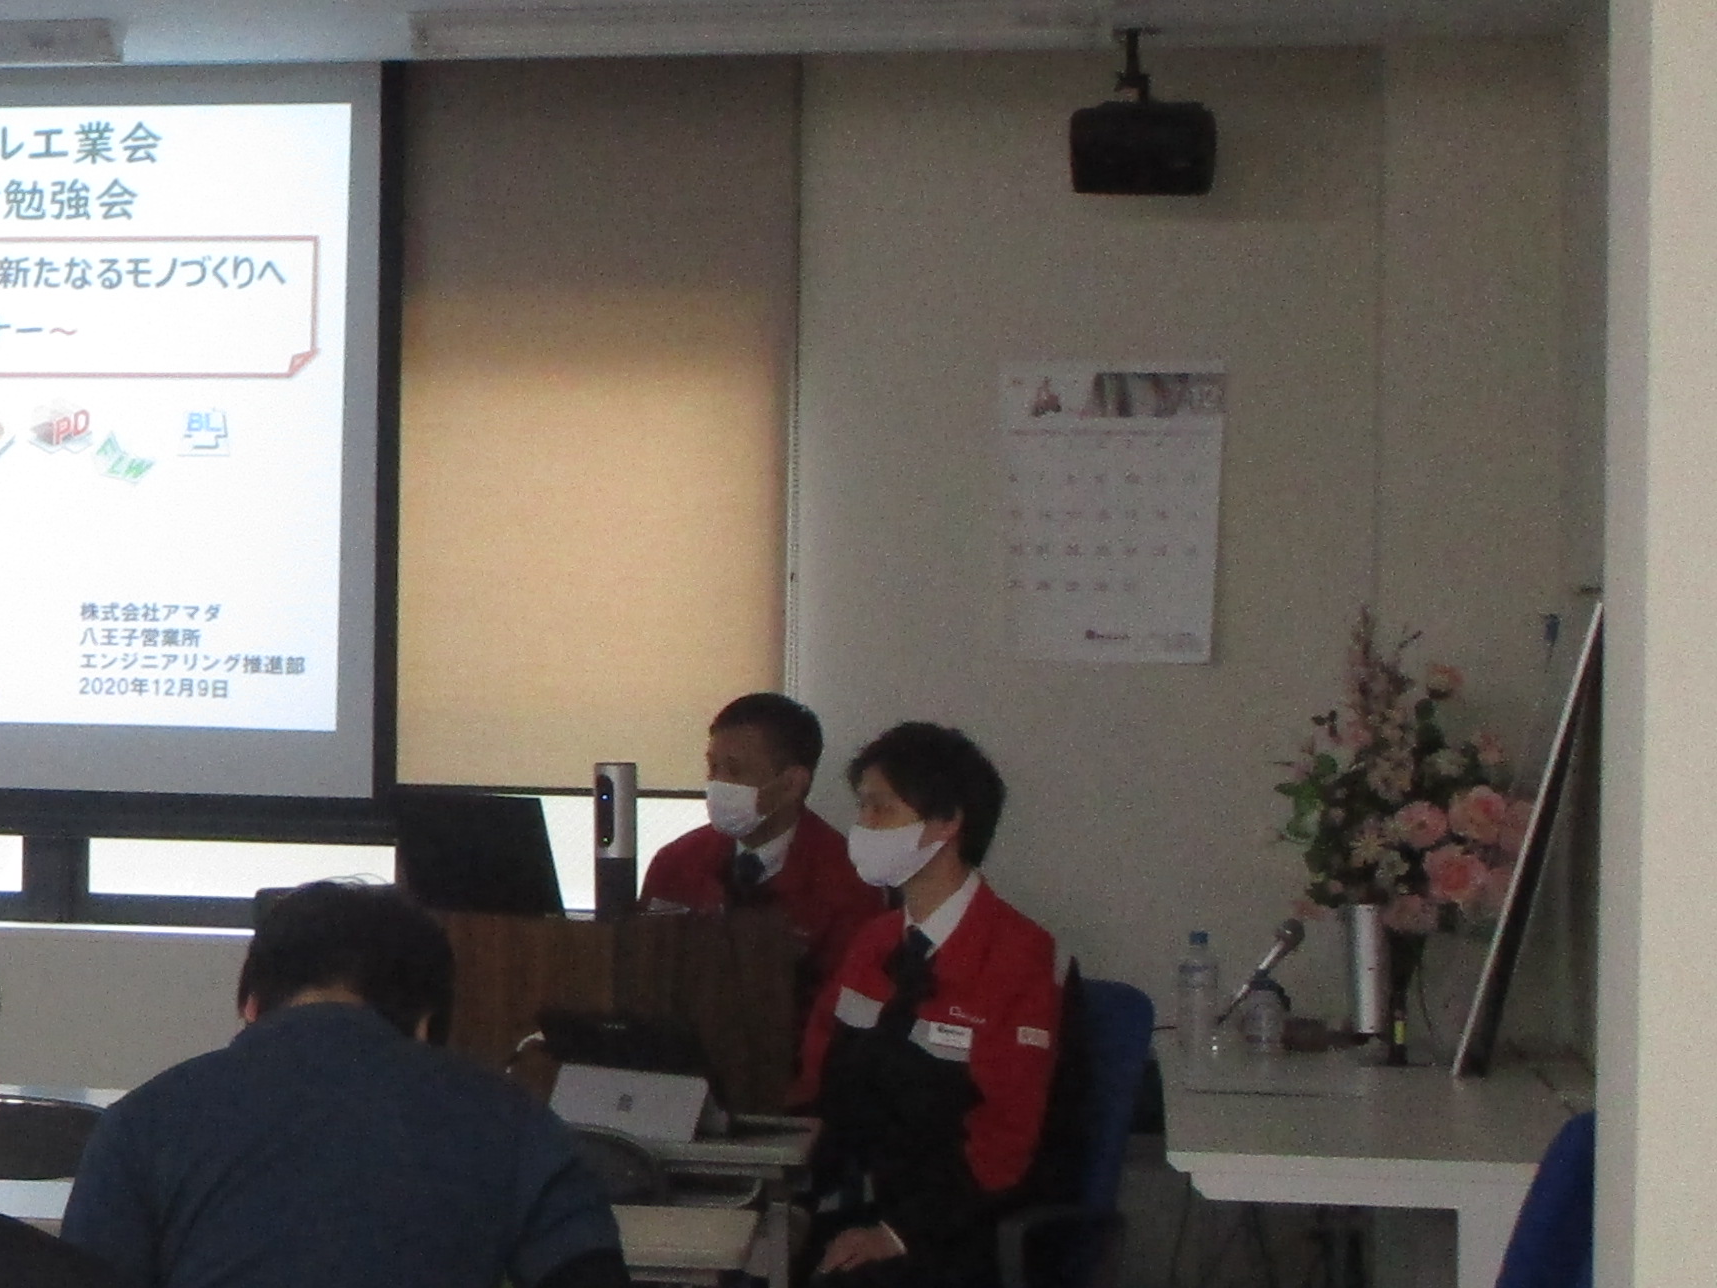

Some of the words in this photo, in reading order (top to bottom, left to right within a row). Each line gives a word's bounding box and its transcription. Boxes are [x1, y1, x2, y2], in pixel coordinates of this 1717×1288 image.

[80, 602, 222, 622] 株式会社アマダ
[80, 627, 201, 648] 八王子営業所
[80, 652, 306, 675] エンジニアリング推進部
[79, 677, 229, 699] 2020年12月9日
